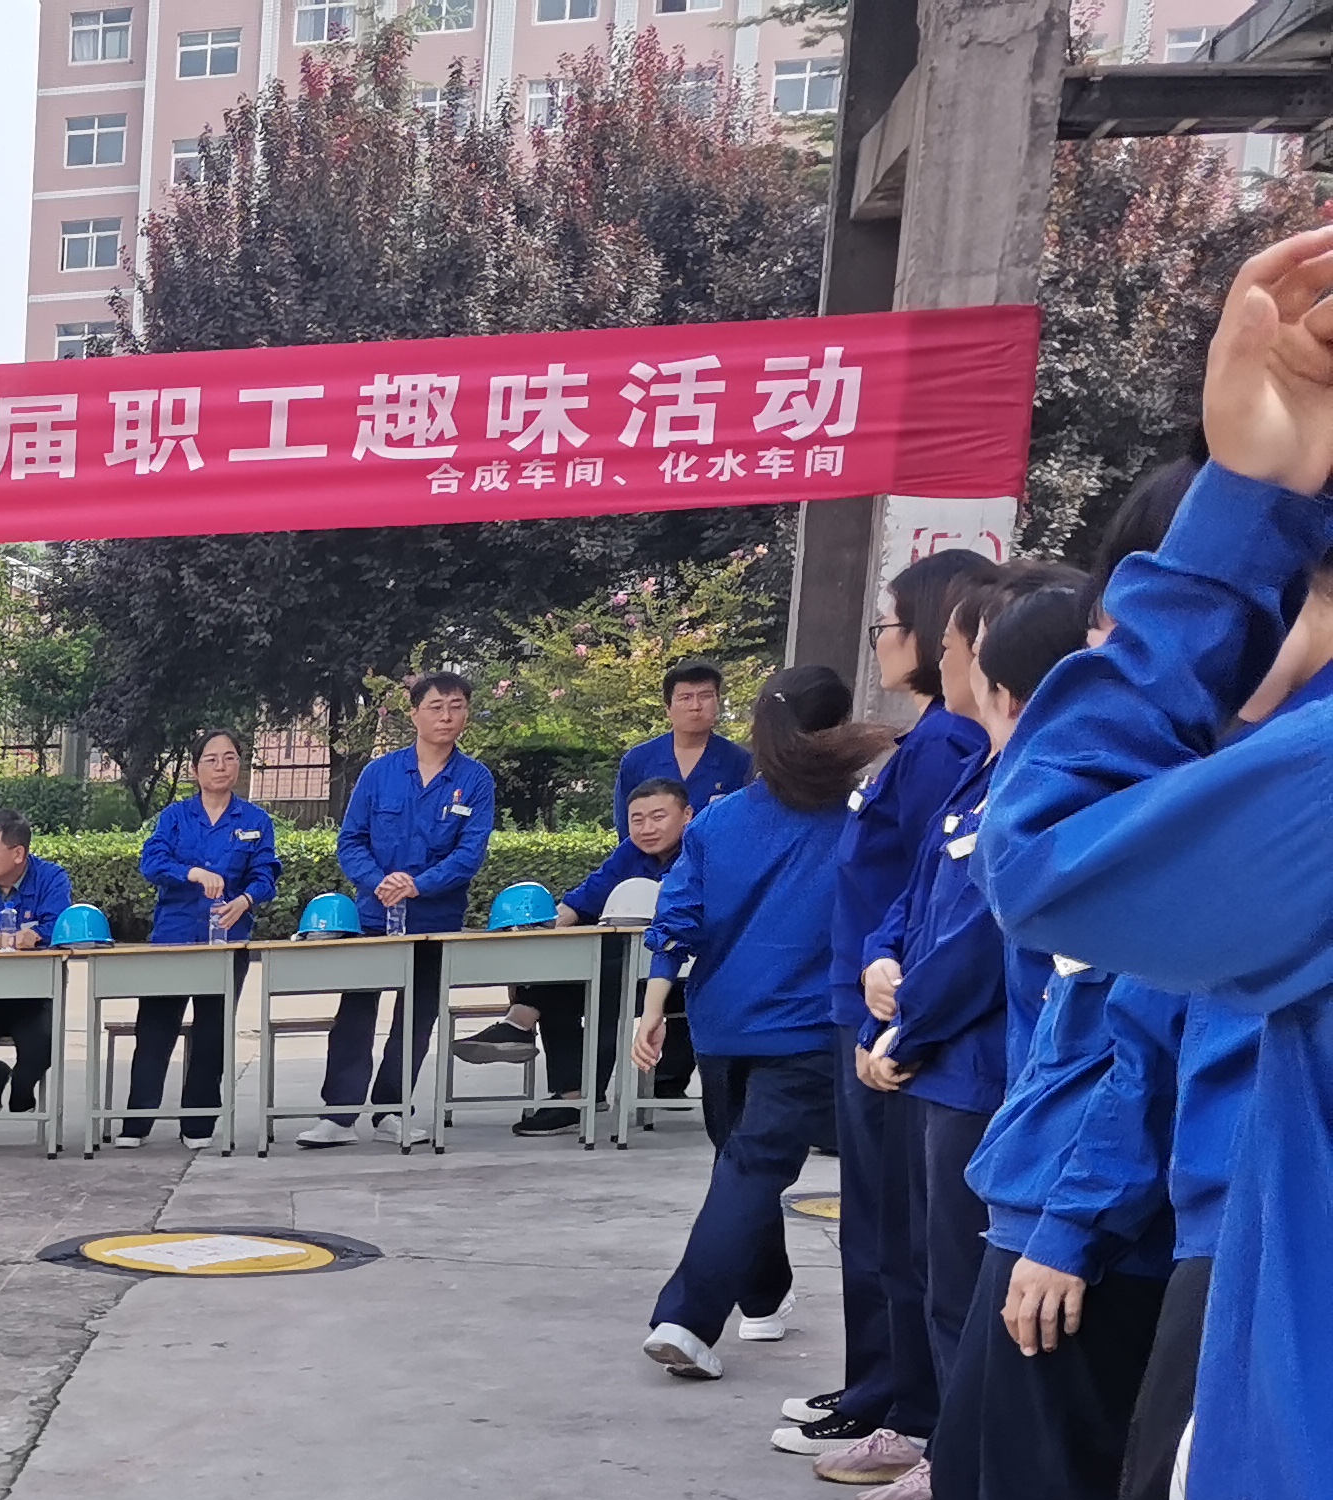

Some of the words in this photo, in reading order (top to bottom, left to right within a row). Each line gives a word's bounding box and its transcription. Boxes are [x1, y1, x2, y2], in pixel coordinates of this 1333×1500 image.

[425, 443, 845, 495] 合成车间、化水车间
